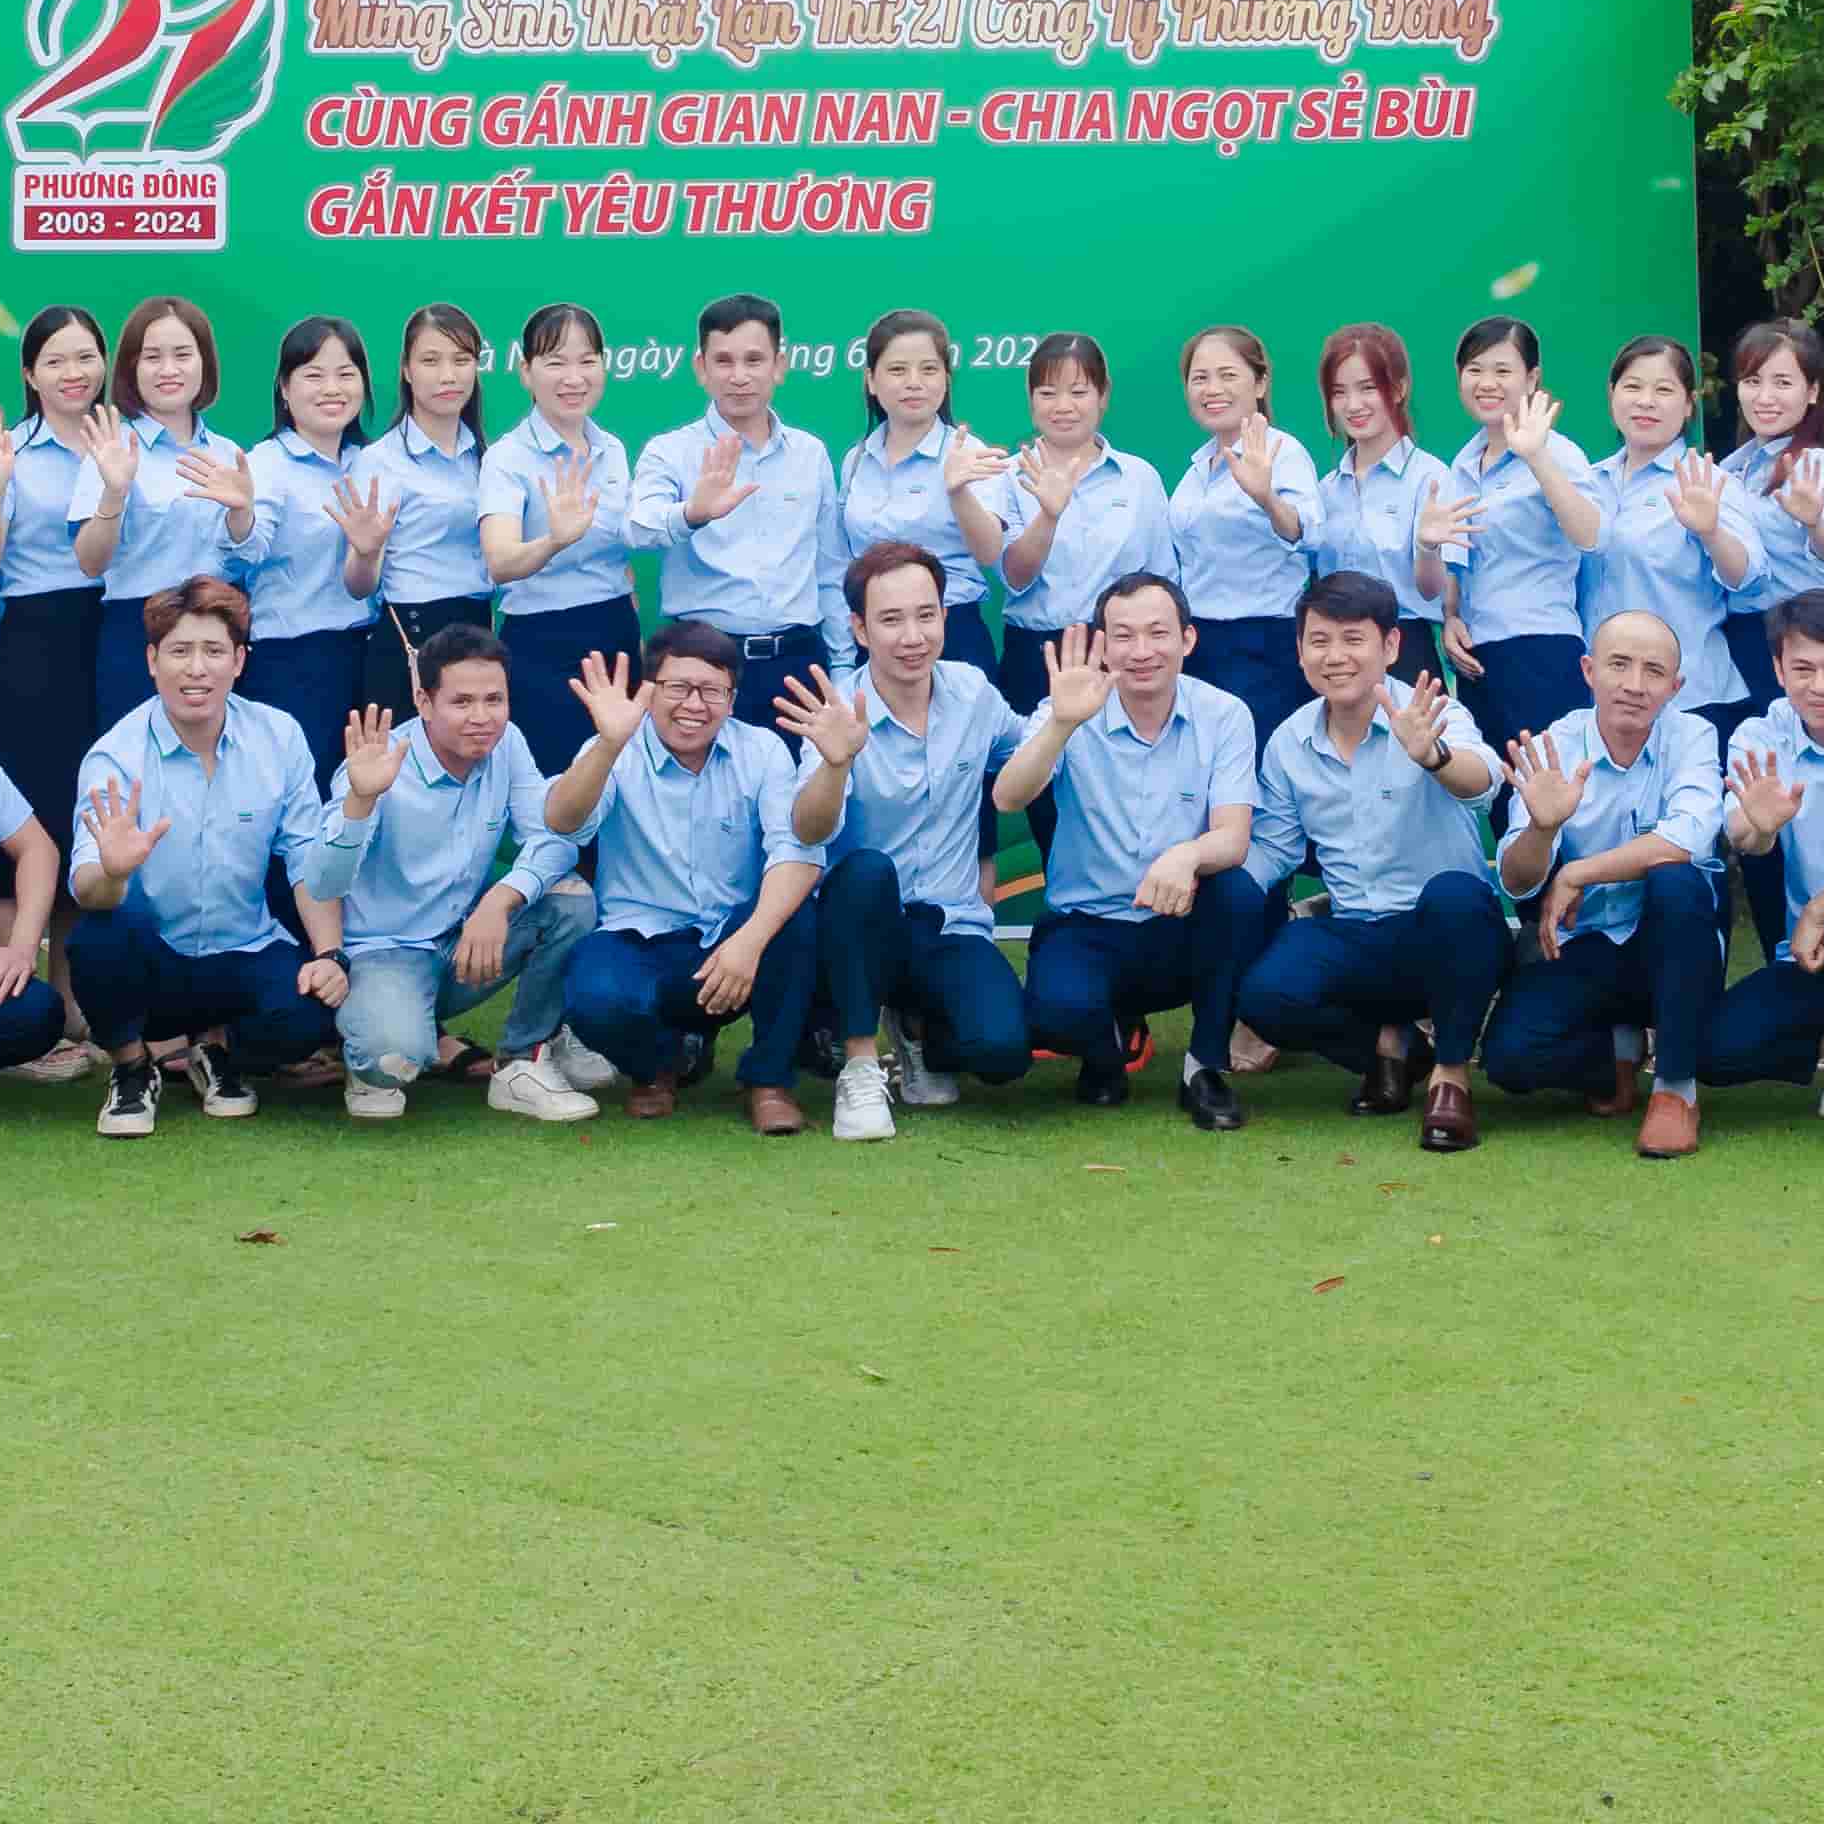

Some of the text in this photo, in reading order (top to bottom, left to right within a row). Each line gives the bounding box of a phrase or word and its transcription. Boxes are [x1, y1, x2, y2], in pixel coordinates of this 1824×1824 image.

[307, 85, 472, 148] CÙNG
[481, 84, 650, 147] GÁNH
[658, 93, 804, 145] GIAN
[811, 92, 941, 145] NAN
[980, 91, 1114, 143] CHIA
[1126, 90, 1290, 157] NGỌT
[1294, 73, 1365, 140] SẺ
[1372, 77, 1474, 139] BÙI
[23, 168, 217, 199] PHƯƠNG ĐÔNG
[308, 169, 932, 236] GẮN KẾT YÊU THƯƠNG
[37, 210, 107, 234] 2003
[133, 210, 203, 234] 2024
[969, 336, 1040, 369] 202
